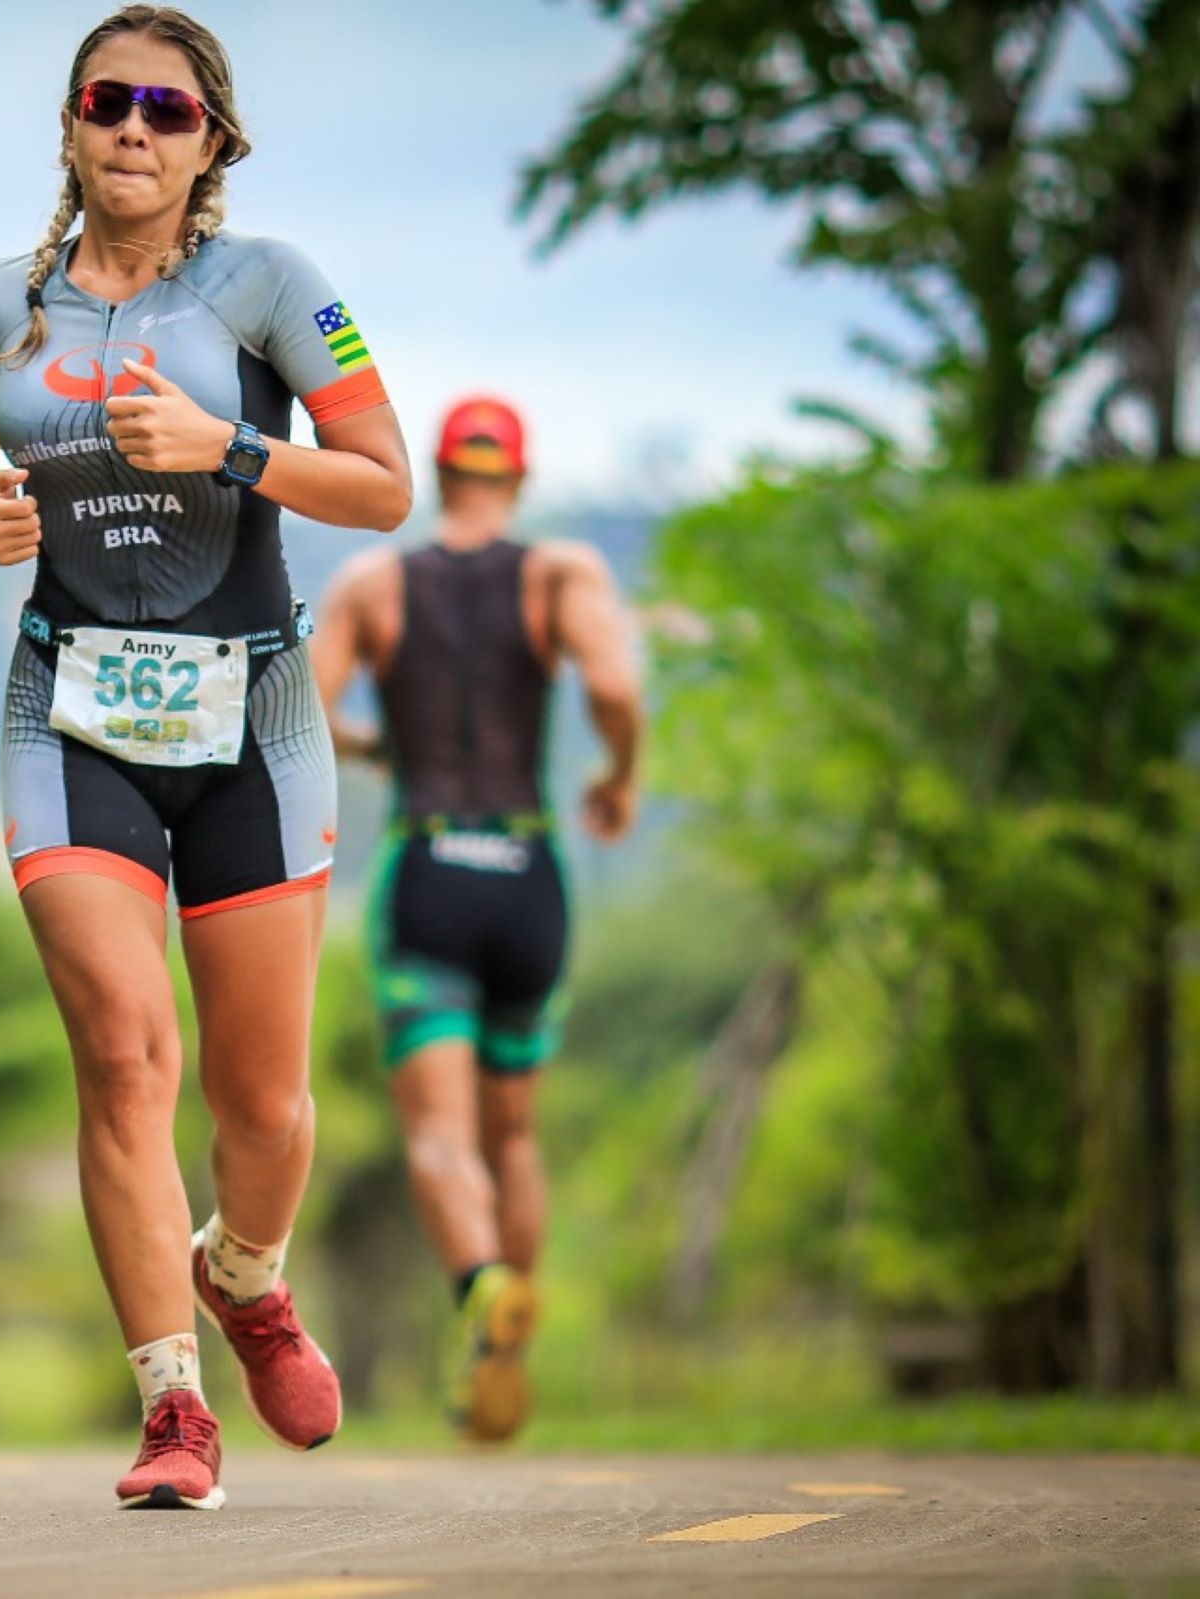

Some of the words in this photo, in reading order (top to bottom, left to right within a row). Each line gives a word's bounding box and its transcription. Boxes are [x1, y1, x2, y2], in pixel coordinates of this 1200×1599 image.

[8, 437, 111, 466] uilherm
[72, 494, 184, 521] FURUYA
[104, 526, 161, 549] BRA
[121, 638, 176, 659] Anny
[94, 655, 200, 711] 562
